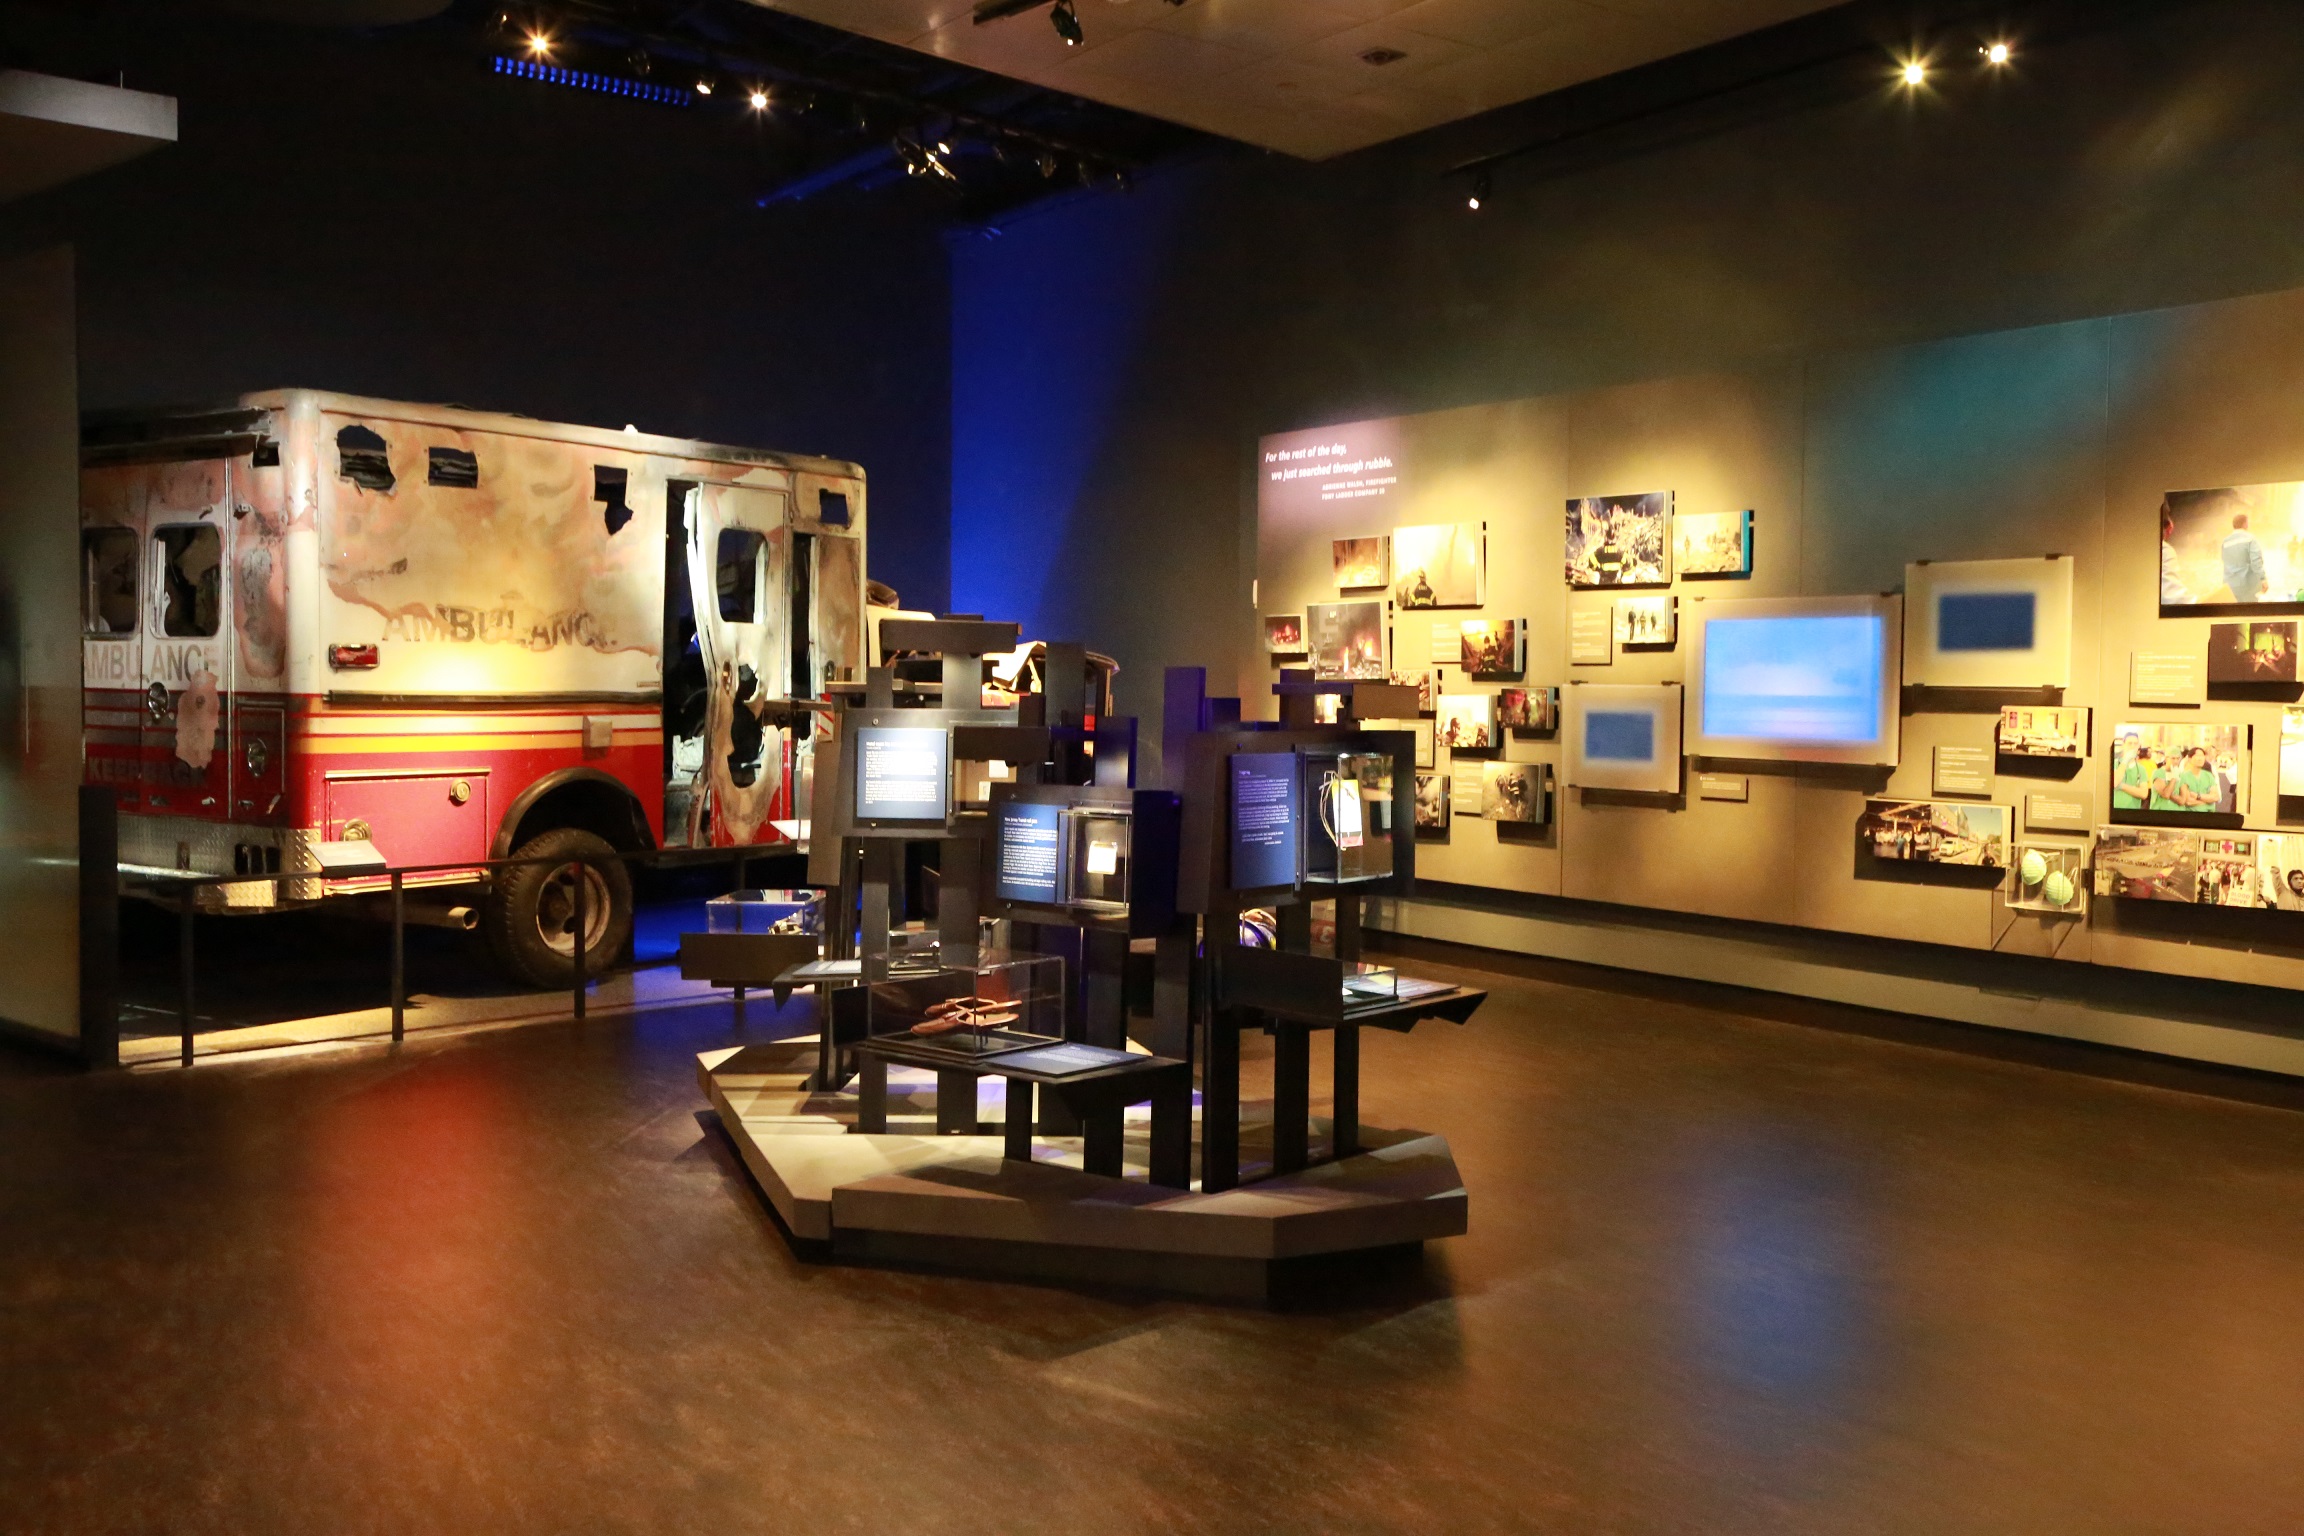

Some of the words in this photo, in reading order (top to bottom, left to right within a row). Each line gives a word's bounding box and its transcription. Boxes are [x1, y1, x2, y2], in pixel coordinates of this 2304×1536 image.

[1265, 452, 1277, 463] For
[1279, 450, 1290, 461] the
[1292, 448, 1306, 460] rest
[1308, 446, 1317, 458] of
[1318, 444, 1330, 456] the
[1331, 443, 1347, 457] day,
[1271, 470, 1282, 481] we
[1283, 468, 1298, 482] just
[1298, 464, 1332, 478] searched
[1332, 459, 1364, 474] through
[1365, 456, 1393, 470] rubble.
[1354, 488, 1379, 498] COMPANY
[382, 603, 618, 649] AMBULANC
